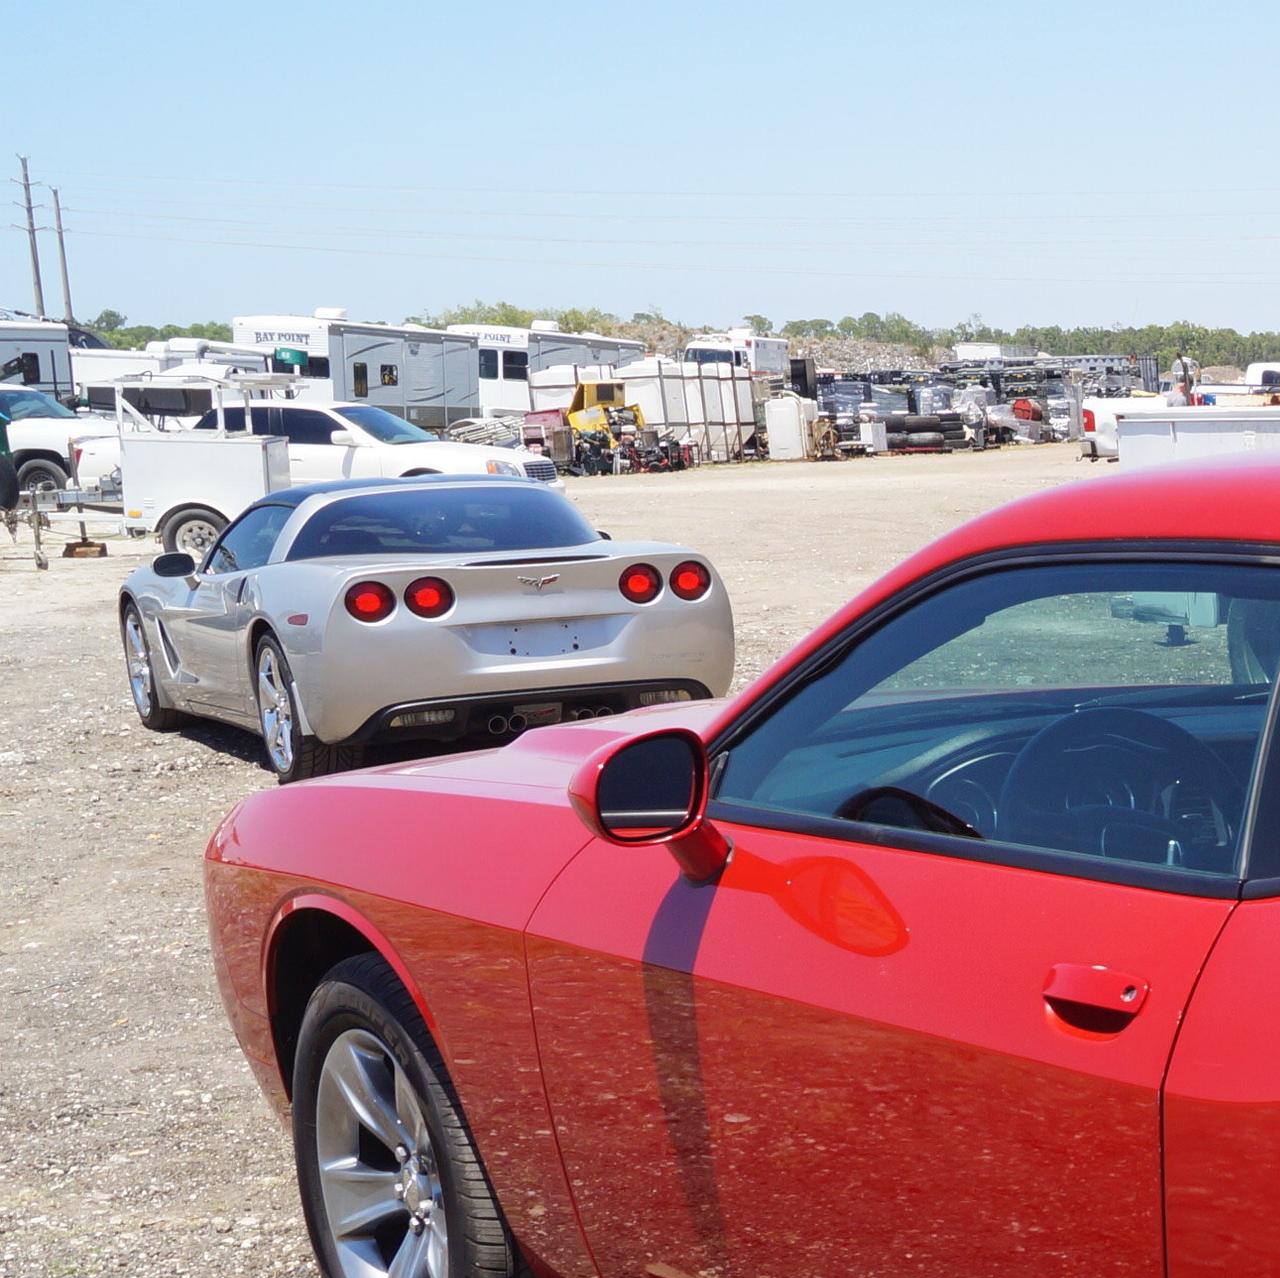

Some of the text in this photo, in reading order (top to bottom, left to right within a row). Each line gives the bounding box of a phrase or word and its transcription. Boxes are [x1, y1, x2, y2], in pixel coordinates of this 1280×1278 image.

[254, 331, 310, 345] BAY POINT
[483, 332, 512, 344] POINT
